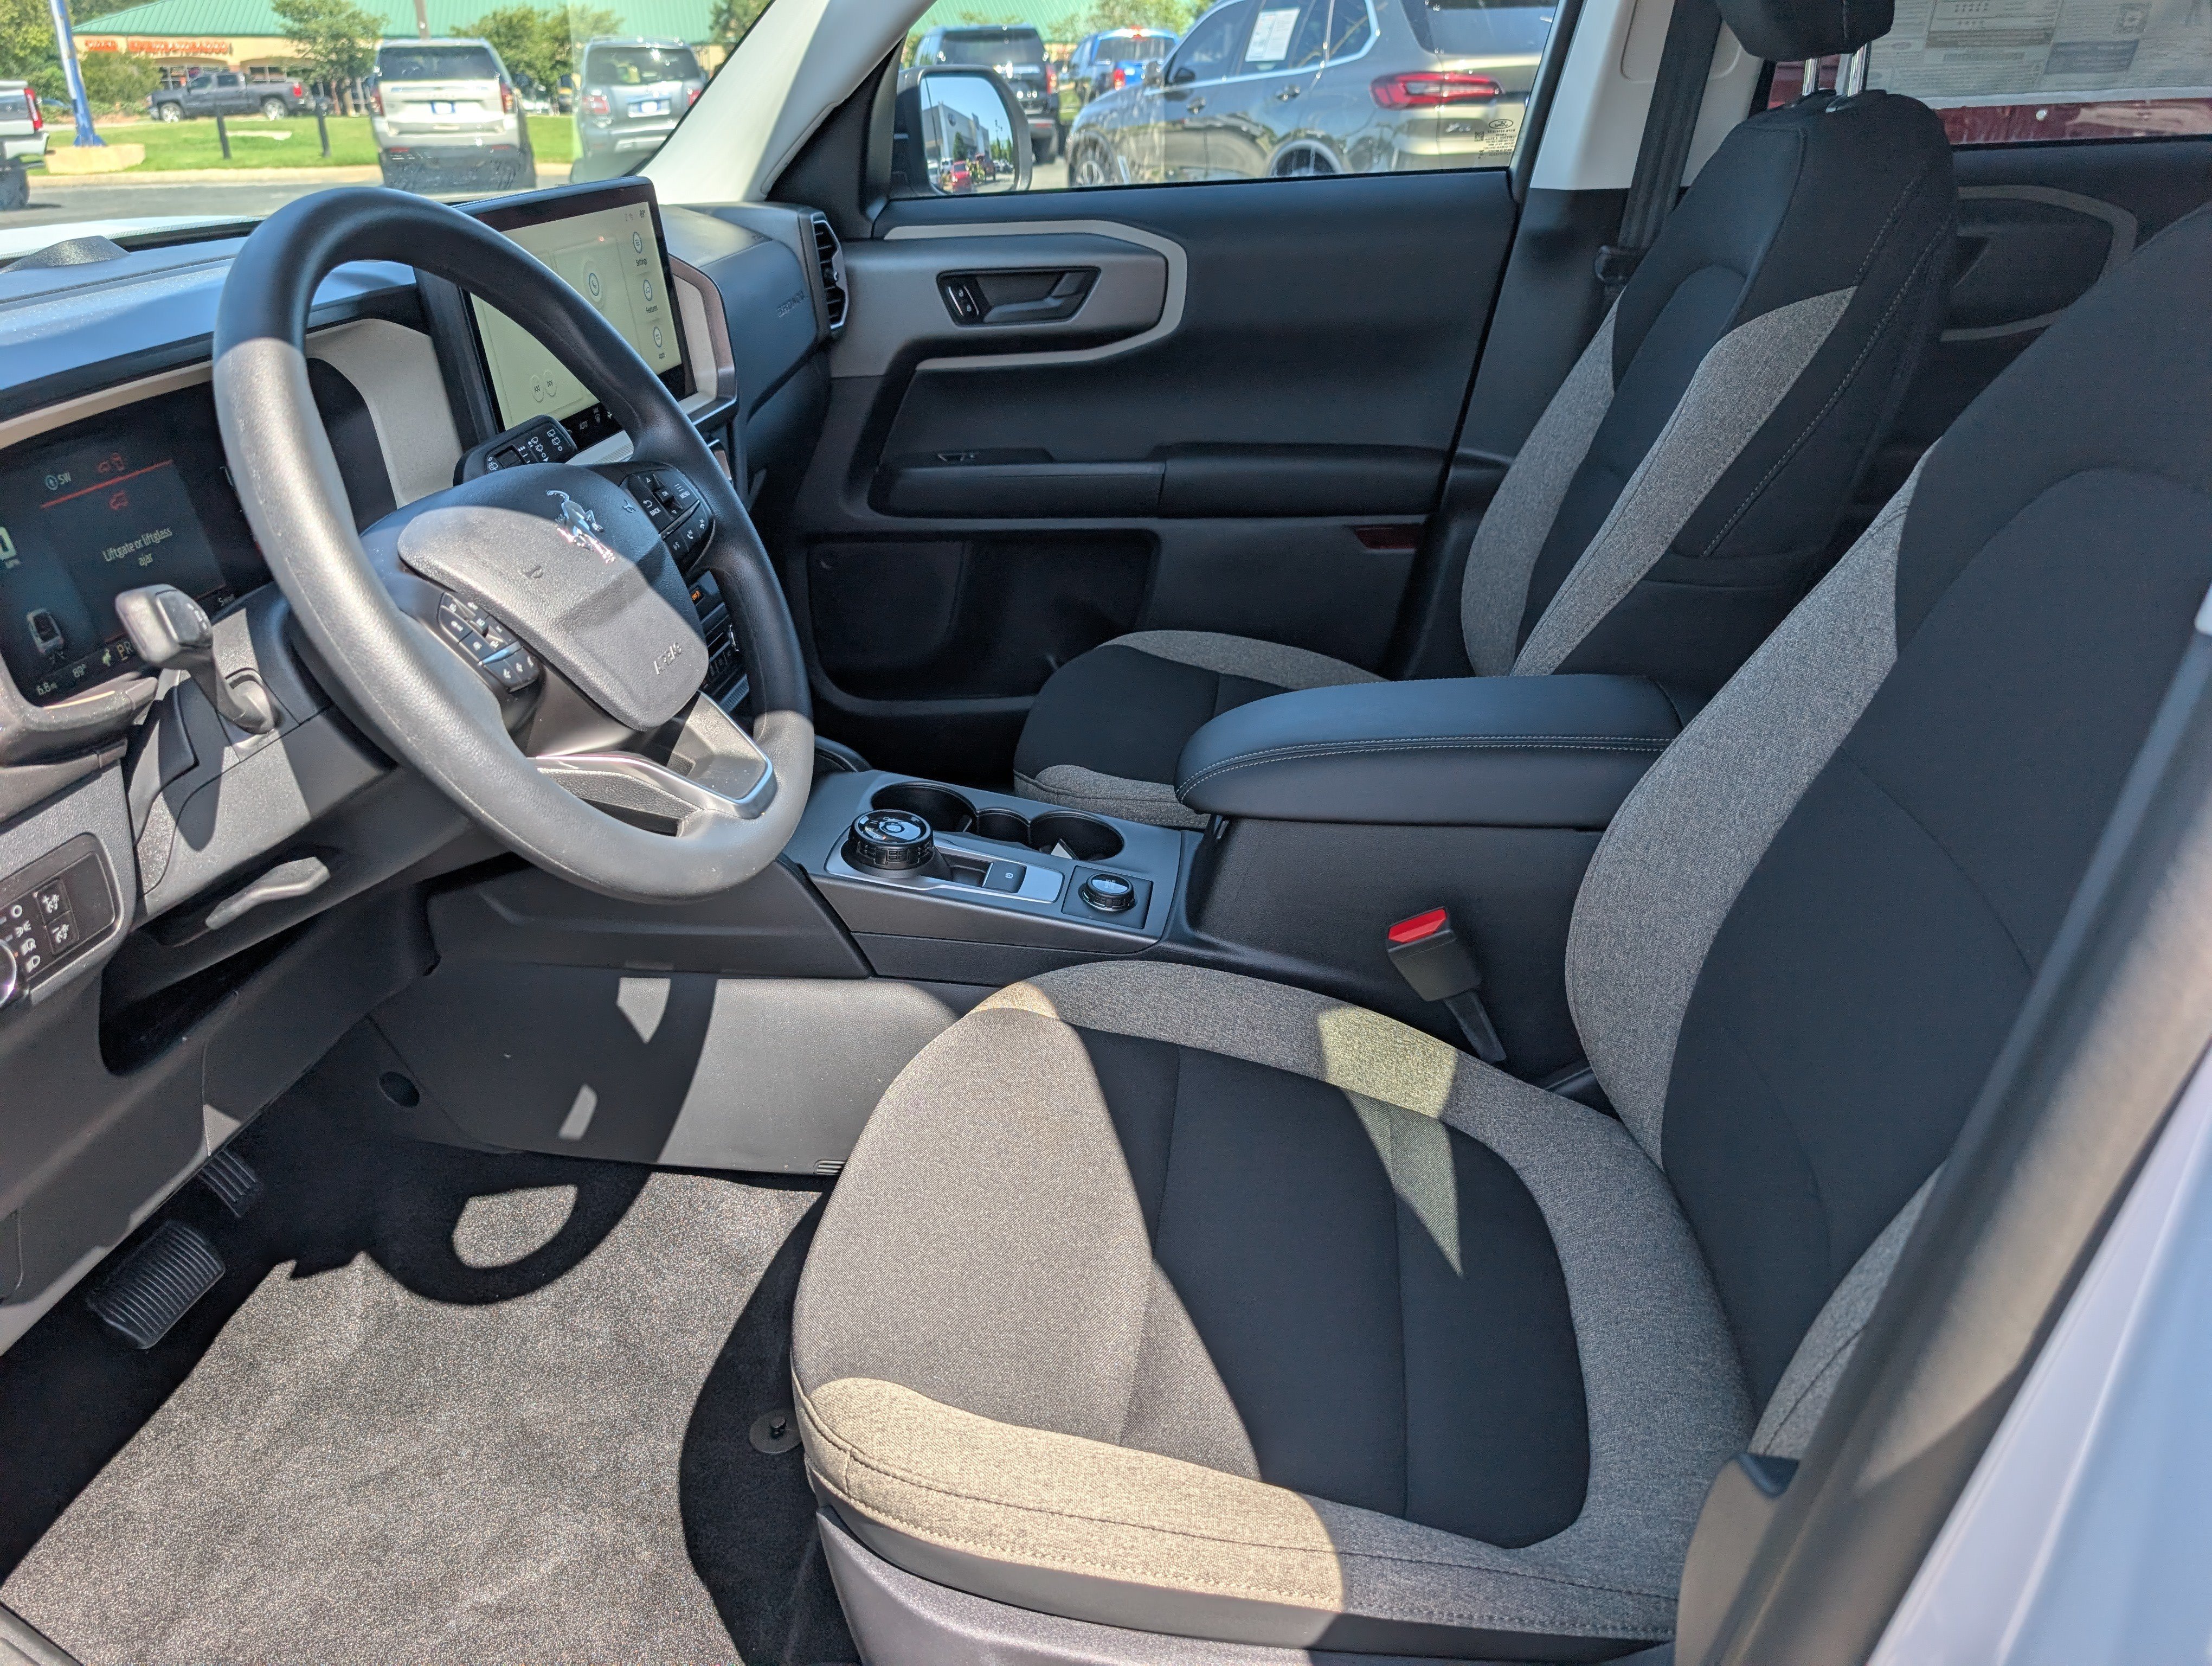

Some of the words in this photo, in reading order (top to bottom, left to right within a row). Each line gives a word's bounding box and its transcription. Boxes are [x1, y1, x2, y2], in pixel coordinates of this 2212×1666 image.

[636, 258, 647, 266] Settings
[646, 305, 658, 313] Features
[58, 472, 72, 485] SW
[679, 490, 691, 499] MENU
[650, 507, 661, 516] BACK
[101, 543, 135, 562] Liftgate
[134, 539, 143, 549] or
[142, 527, 173, 546] liftglass
[138, 553, 153, 566] ajar
